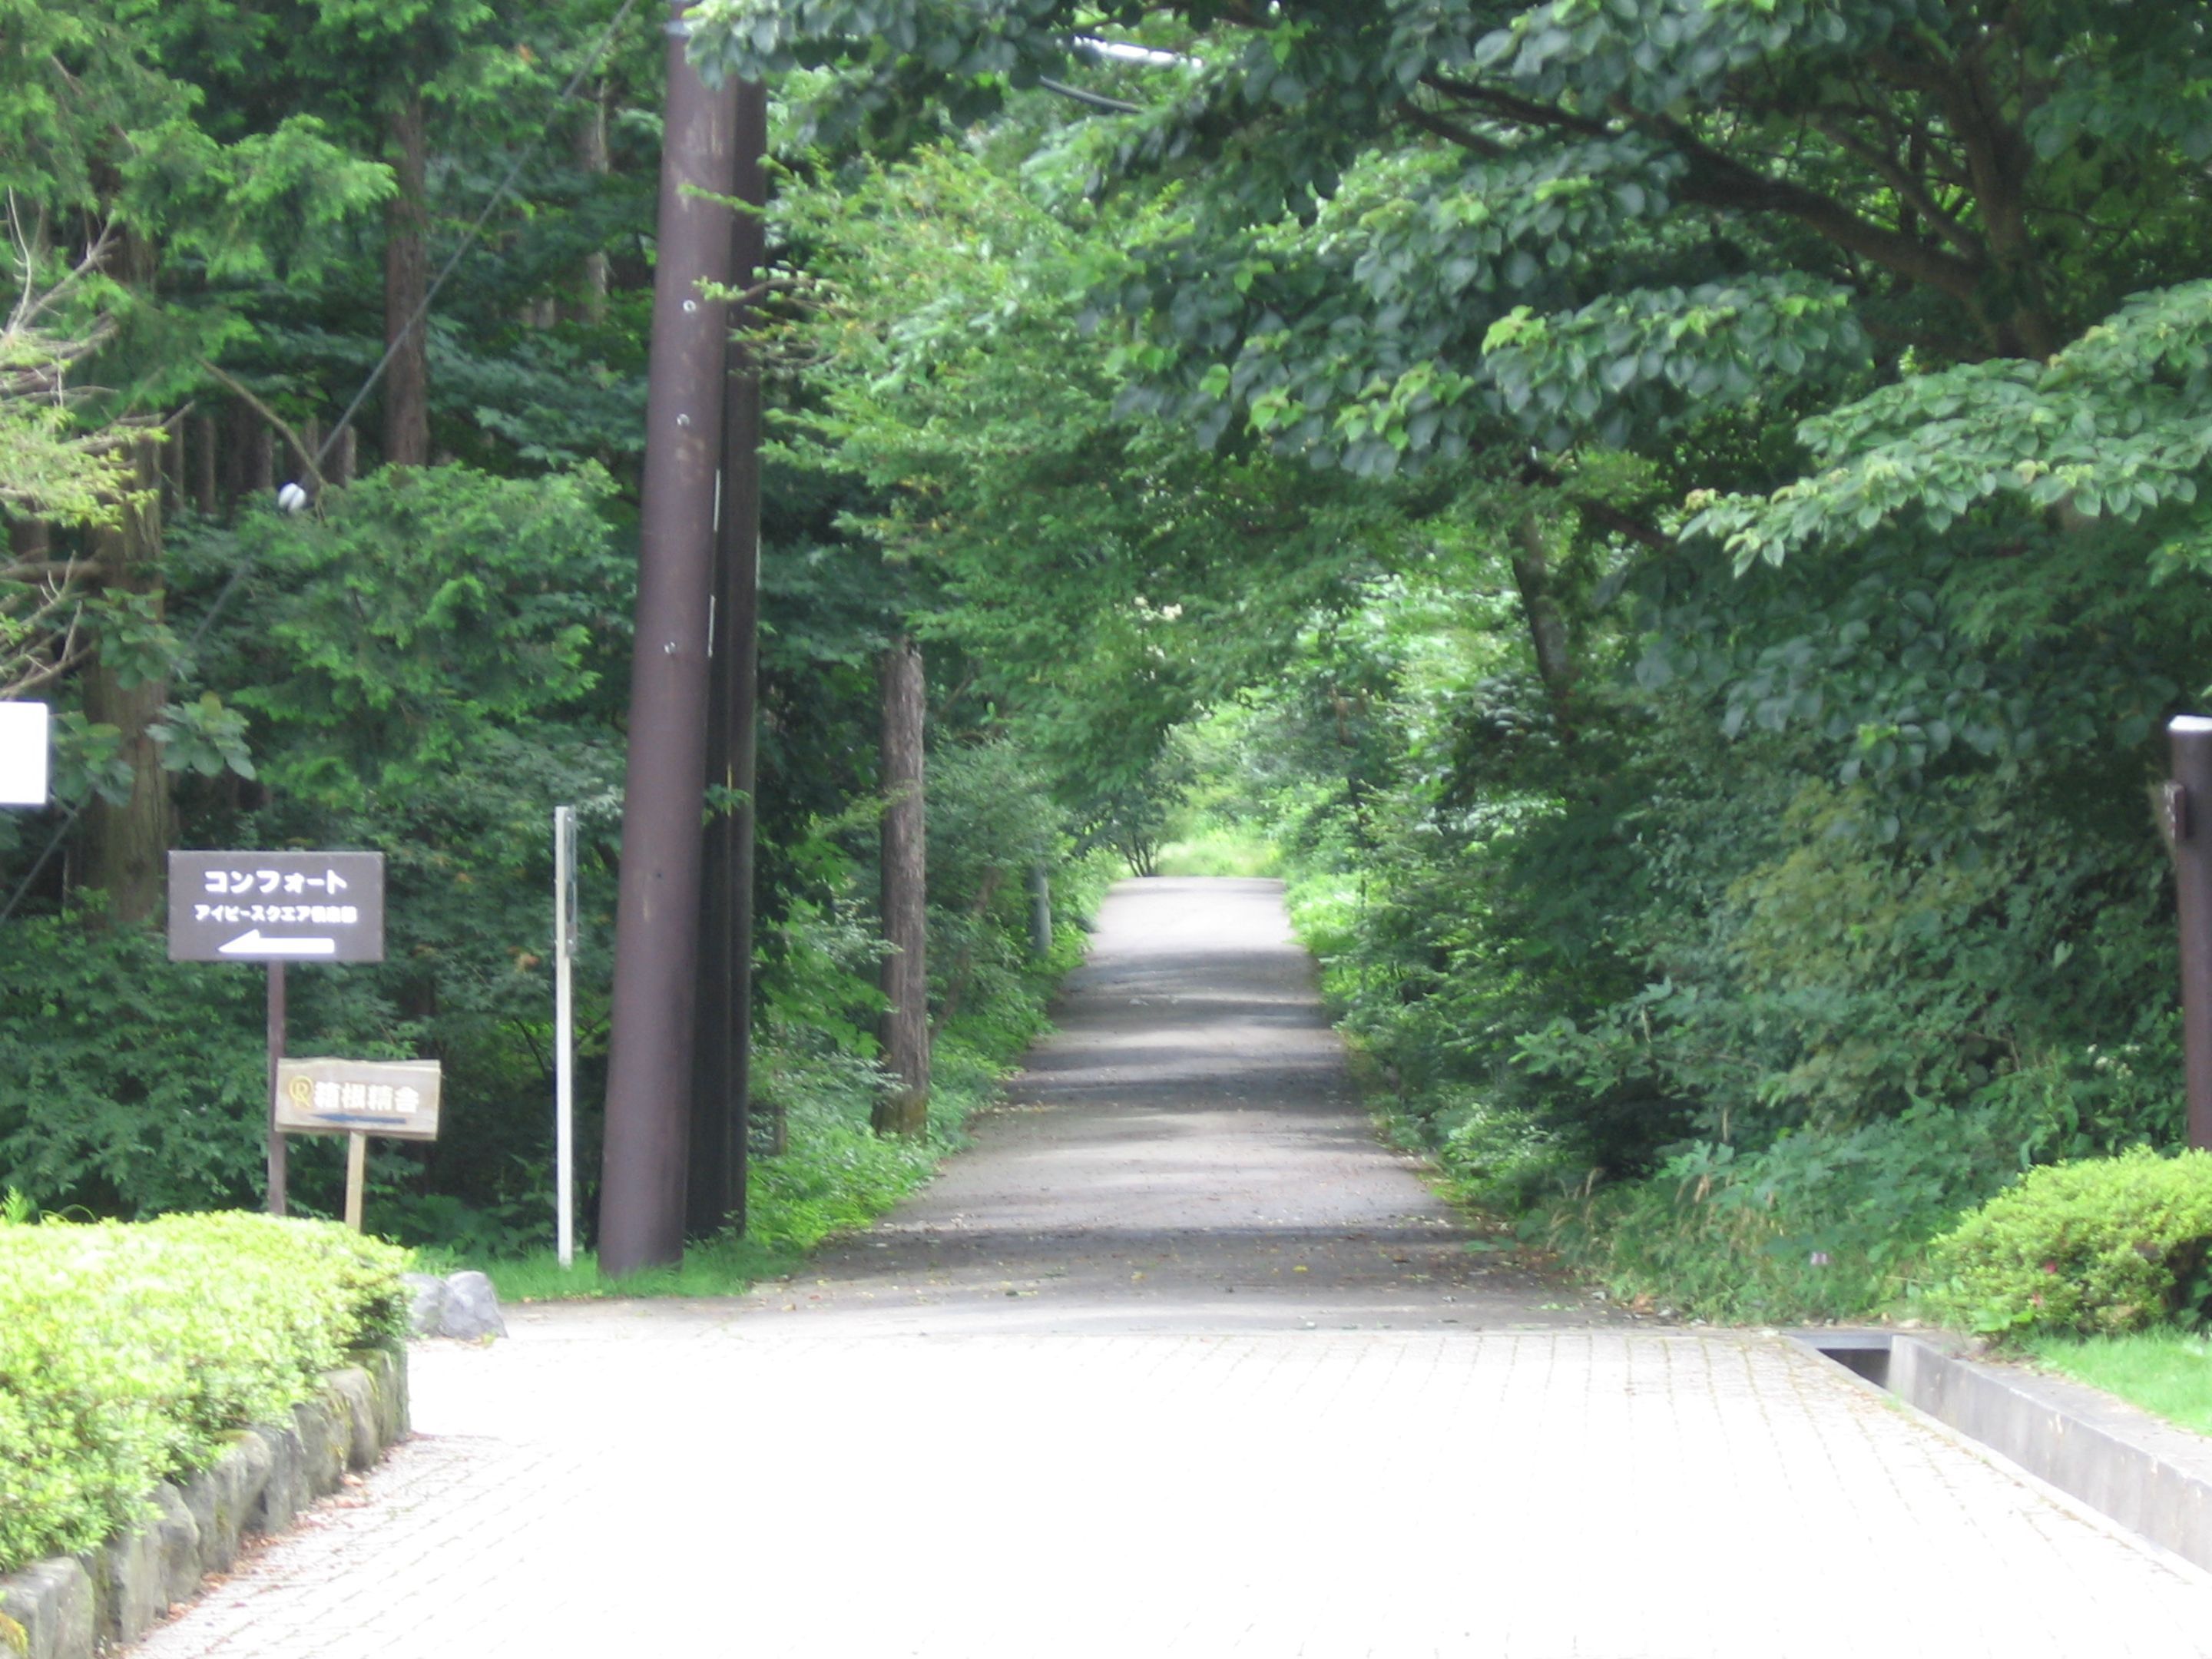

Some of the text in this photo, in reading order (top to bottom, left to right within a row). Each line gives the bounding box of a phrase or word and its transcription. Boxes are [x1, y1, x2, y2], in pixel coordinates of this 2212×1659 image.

[204, 869, 349, 895] コンフォート
